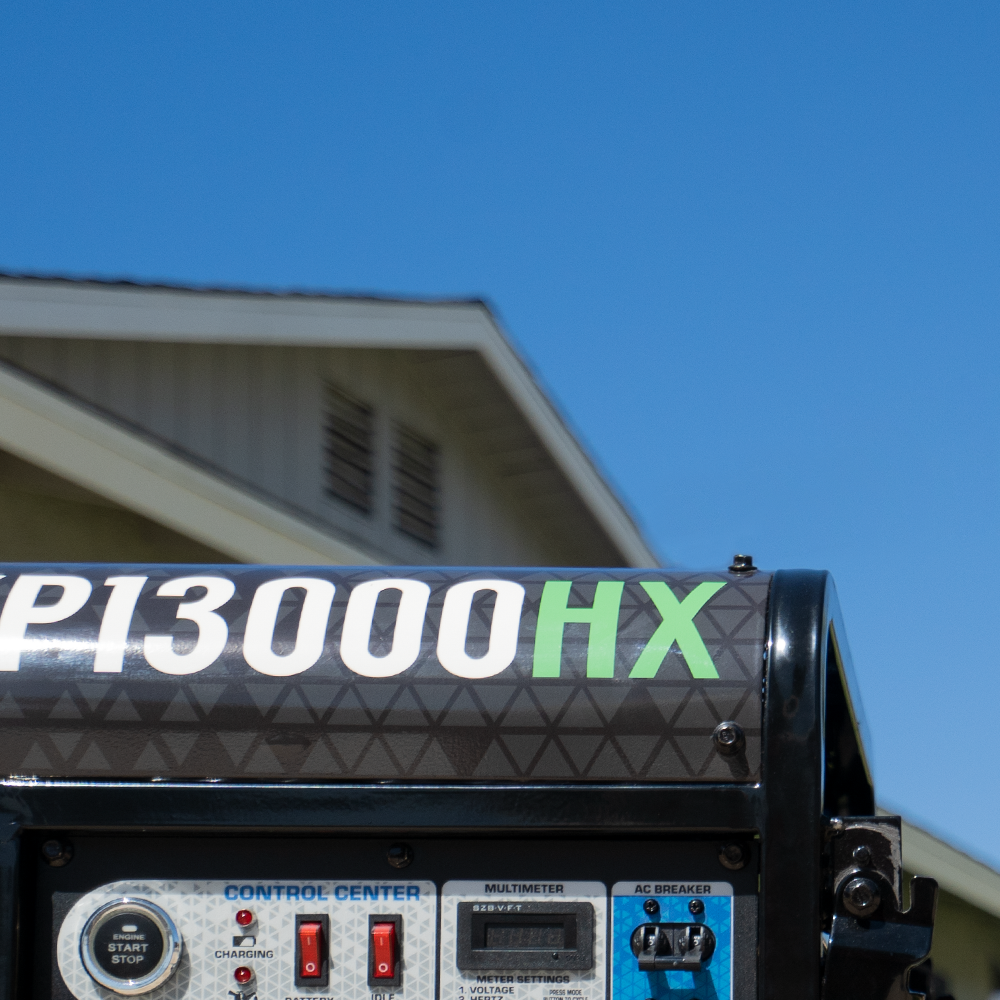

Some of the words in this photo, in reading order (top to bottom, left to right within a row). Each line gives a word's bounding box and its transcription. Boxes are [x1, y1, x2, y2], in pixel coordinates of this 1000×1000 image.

[0, 573, 727, 680] P13000HX
[224, 885, 328, 901] CONTROL
[334, 885, 420, 901] CENTER
[484, 883, 564, 894] MULTIMETER
[634, 884, 651, 894] AC
[654, 884, 711, 895] BREAKER
[112, 933, 145, 941] ENGINE
[107, 943, 149, 953] START
[111, 954, 144, 964] STOP
[214, 950, 274, 959] CHARGING
[476, 975, 514, 984] METER
[515, 975, 570, 984] SETTINGS
[458, 986, 467, 995] 1.
[469, 986, 515, 995] VOLTAGE
